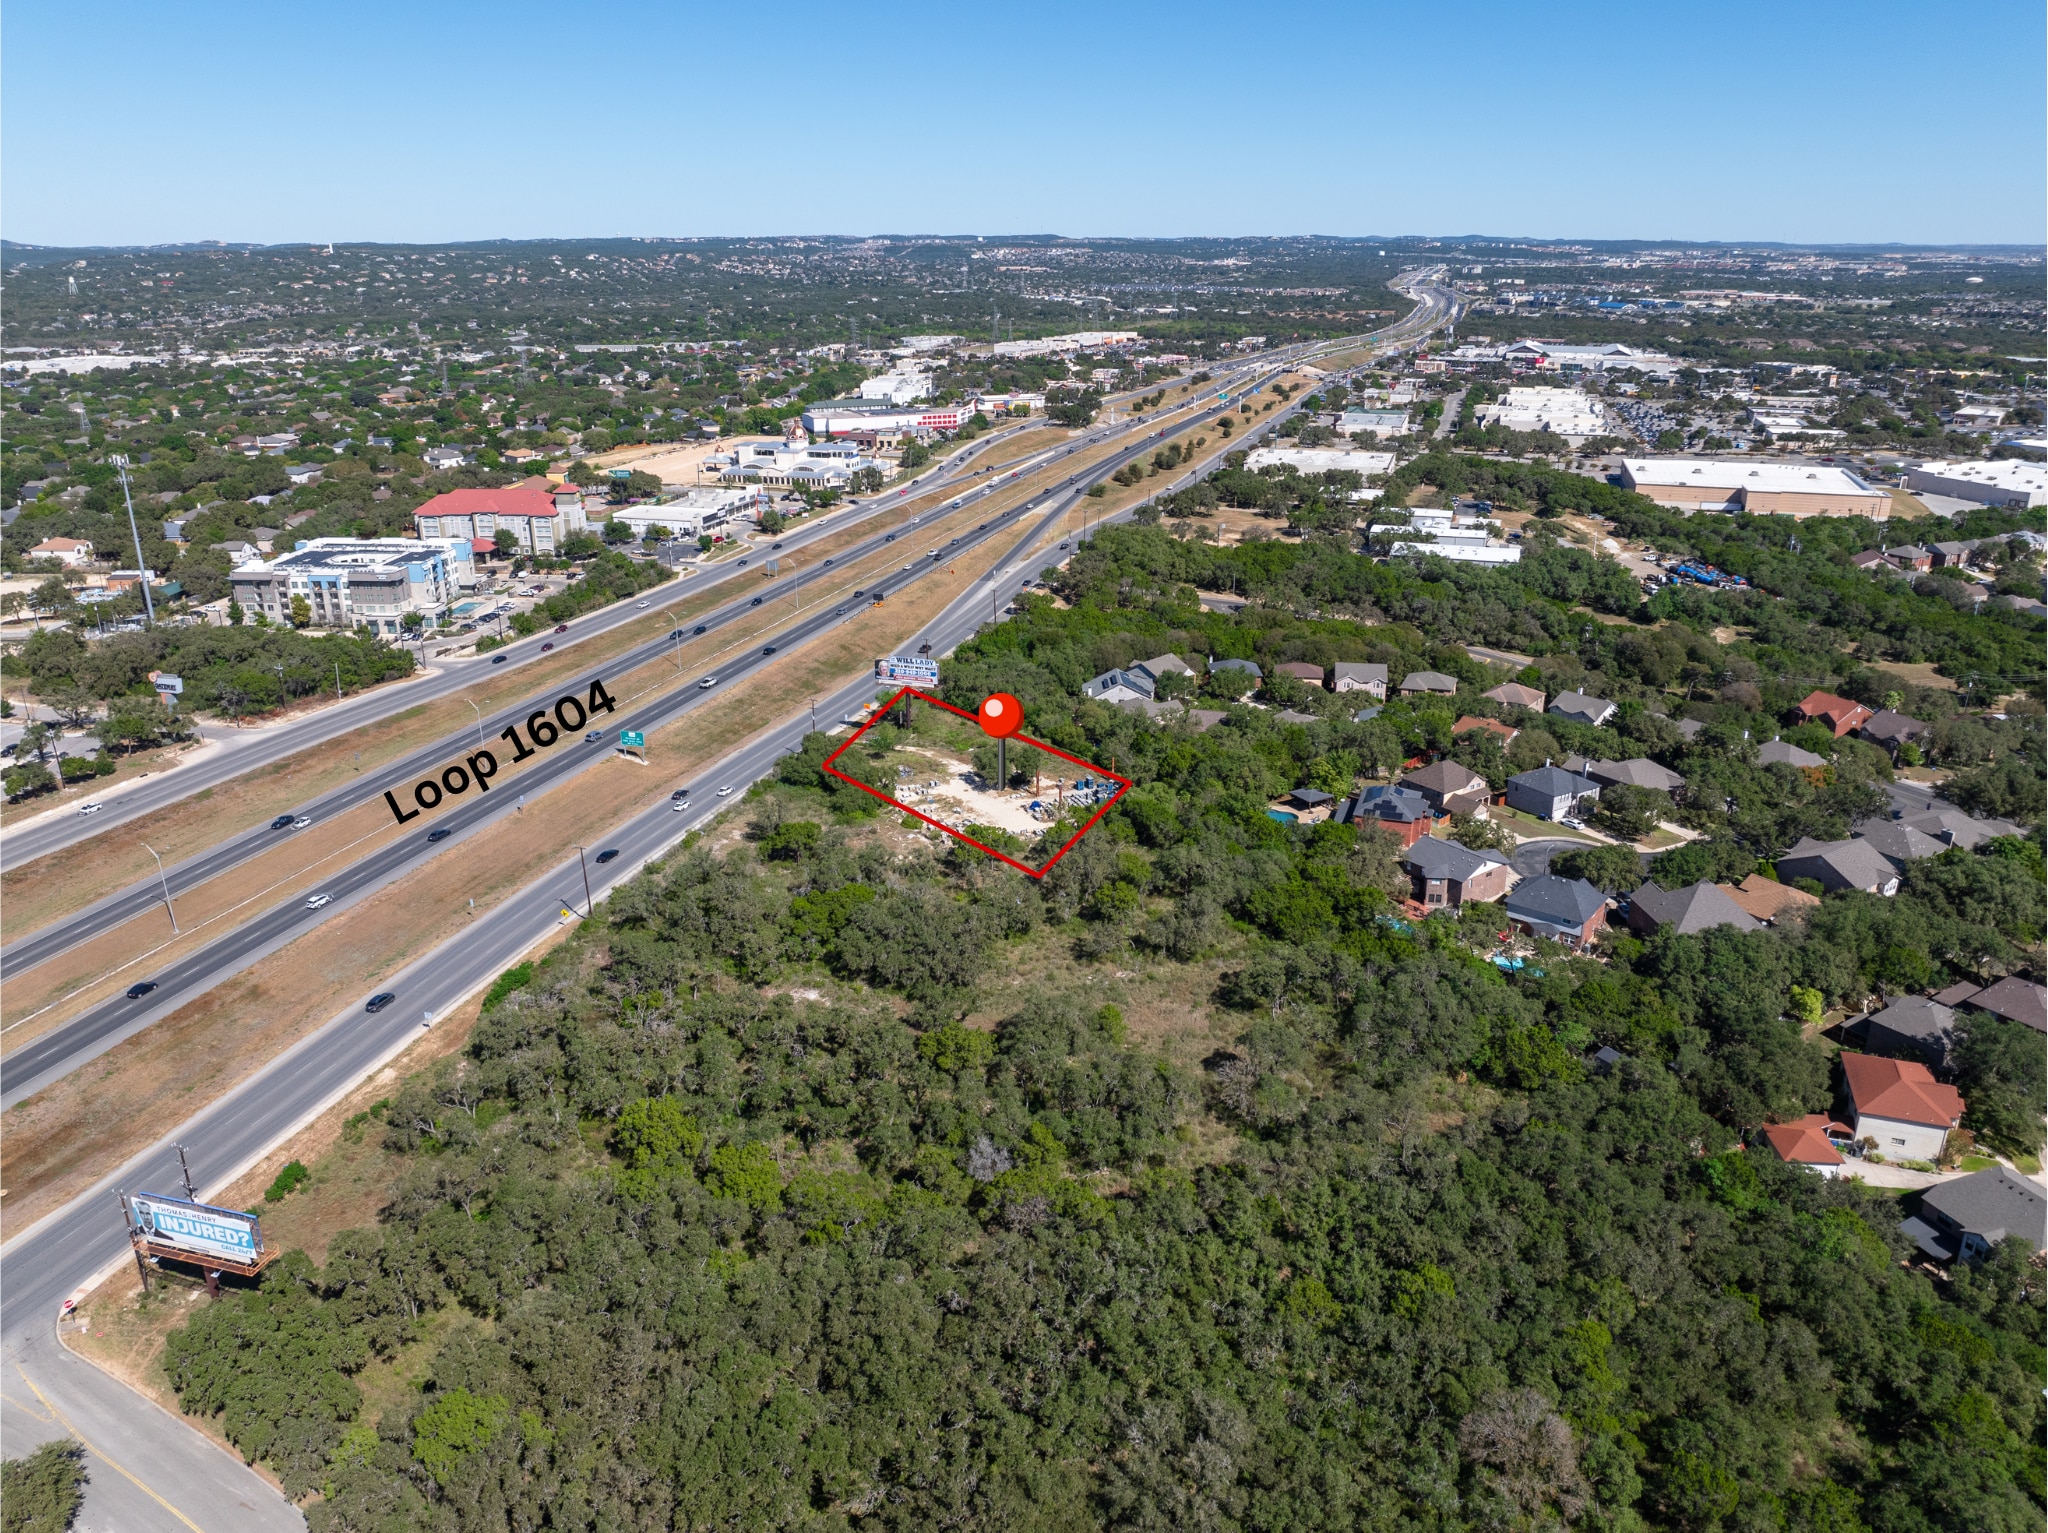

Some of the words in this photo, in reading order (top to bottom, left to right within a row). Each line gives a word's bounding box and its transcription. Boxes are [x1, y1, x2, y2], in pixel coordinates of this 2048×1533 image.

[156, 1206, 188, 1217] THOMAS
[191, 1213, 216, 1223] HENRY
[158, 1214, 249, 1246] INJURED?
[221, 1244, 236, 1252] CALL
[237, 1247, 252, 1255] 24/7
